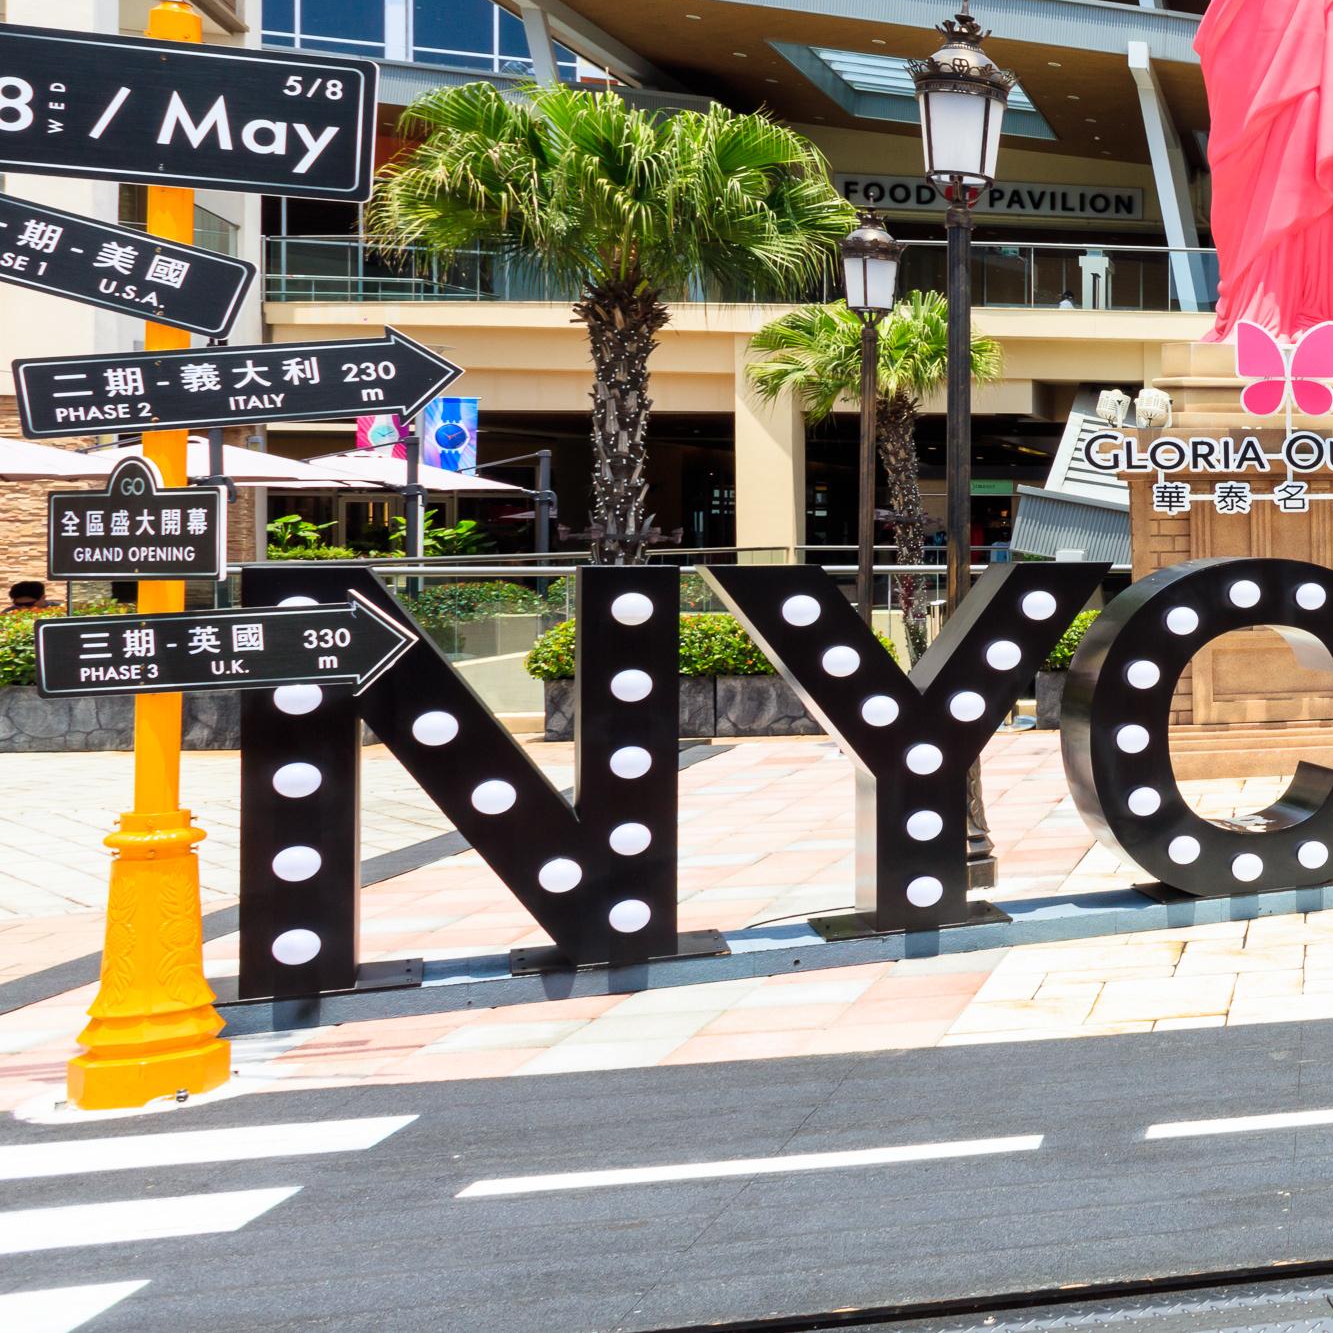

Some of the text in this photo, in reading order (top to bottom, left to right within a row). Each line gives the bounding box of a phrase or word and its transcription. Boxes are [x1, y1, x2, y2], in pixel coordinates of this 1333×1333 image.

[282, 75, 344, 101] 5/8
[47, 82, 67, 135] WED
[156, 90, 341, 174] May
[843, 181, 1135, 214] FOOD PAVILION
[98, 278, 166, 310] U.S.A.
[341, 361, 397, 384] 230
[55, 393, 286, 423] PHASE 2 ITALY
[1083, 433, 1269, 471] GLORIA
[120, 477, 146, 497] GO
[60, 507, 209, 537] 全區盛大開幕
[73, 546, 197, 563] GRAND OPENING
[303, 627, 351, 649] 330
[80, 660, 250, 683] PHASE 3 U.K.
